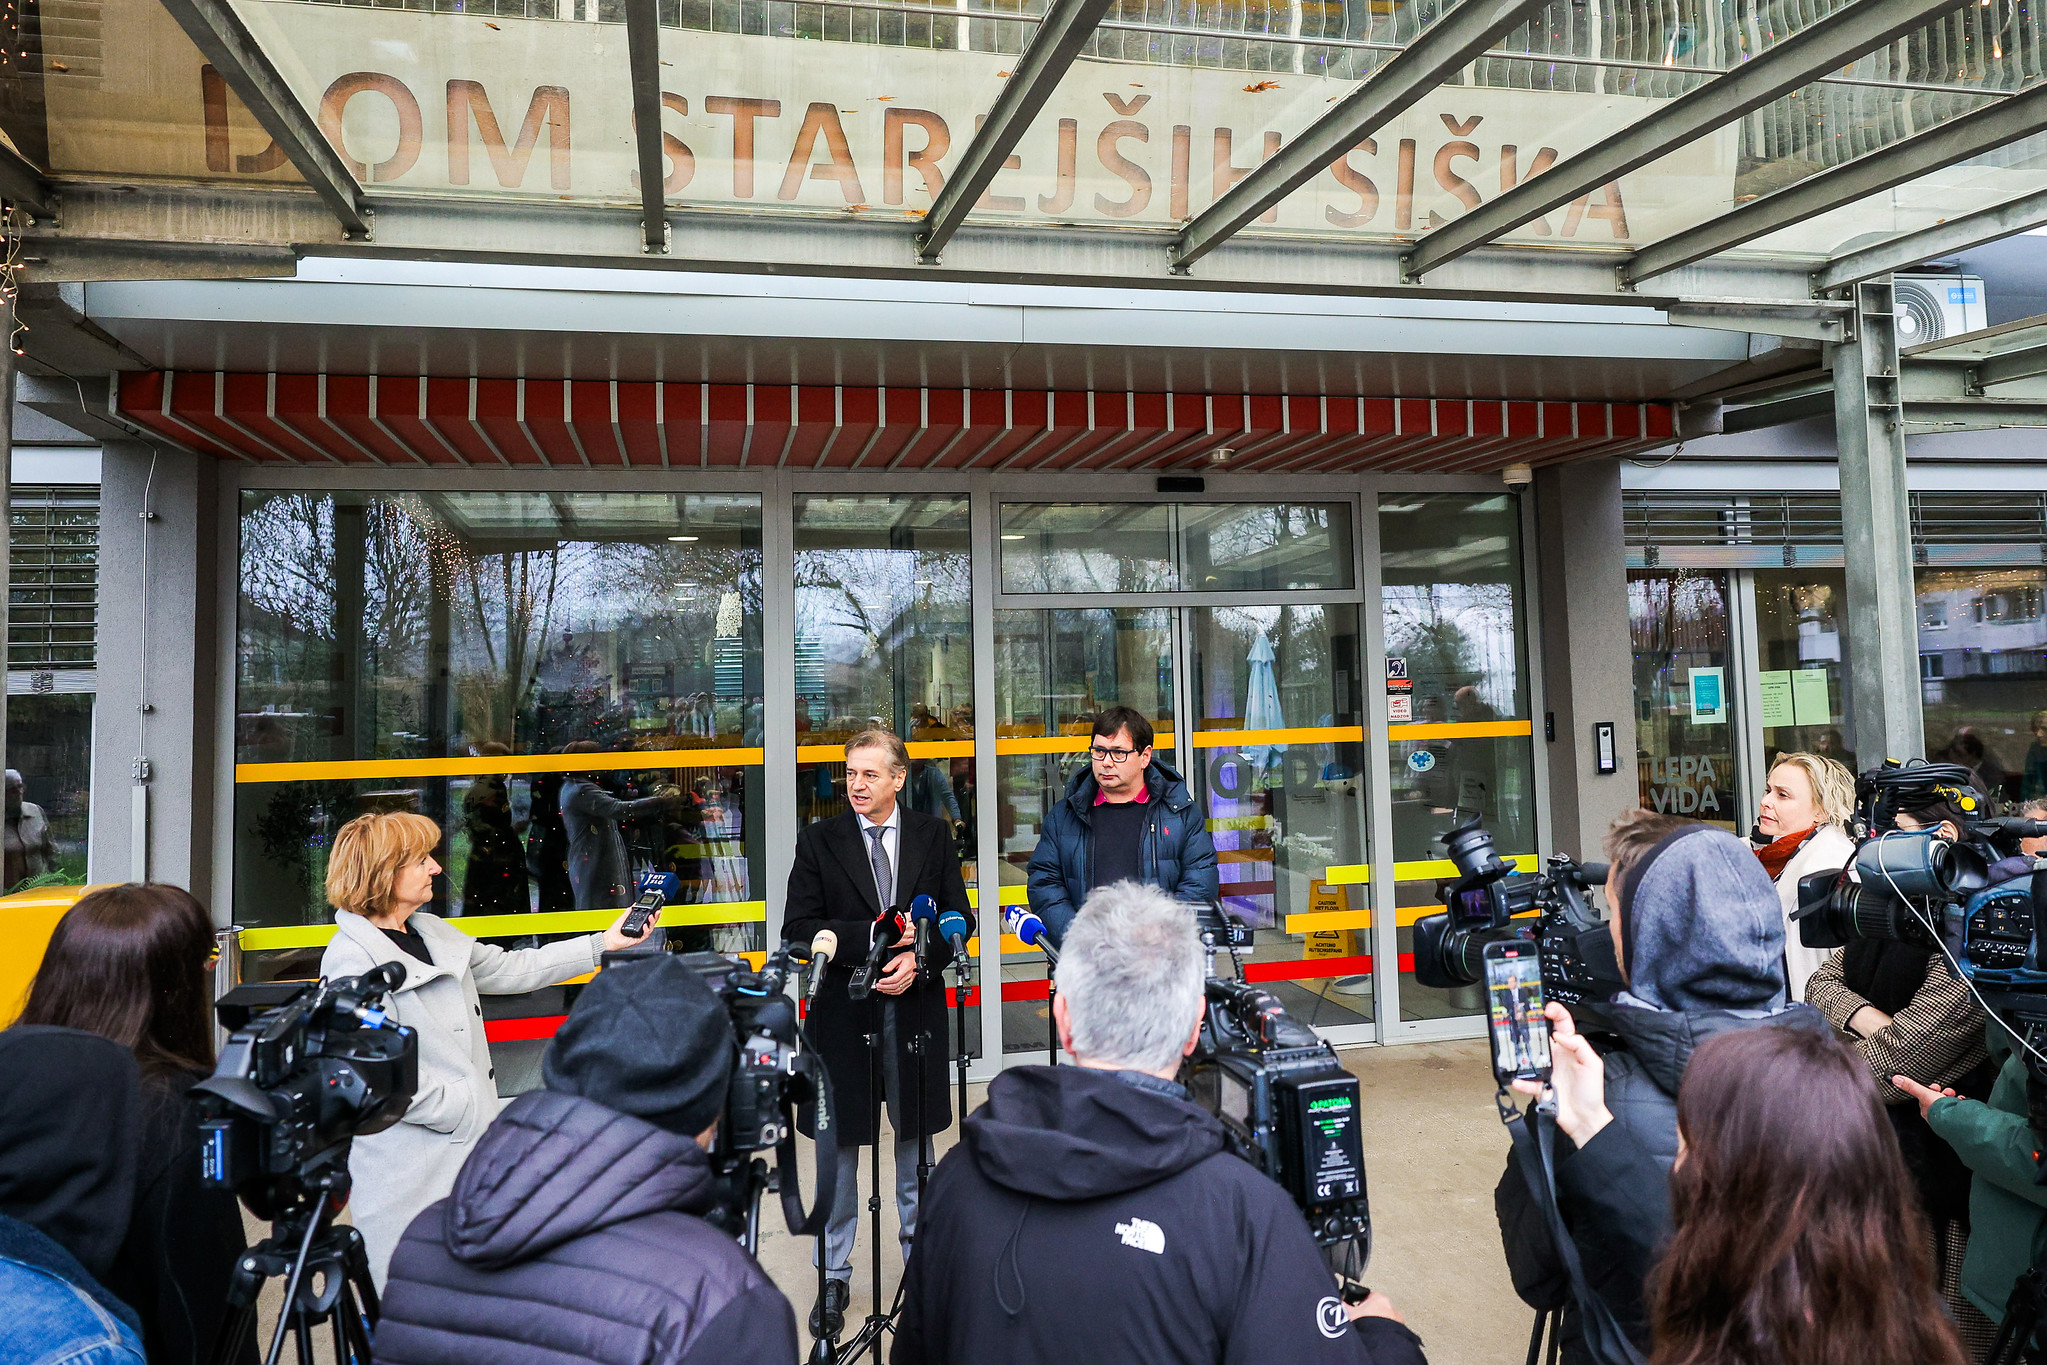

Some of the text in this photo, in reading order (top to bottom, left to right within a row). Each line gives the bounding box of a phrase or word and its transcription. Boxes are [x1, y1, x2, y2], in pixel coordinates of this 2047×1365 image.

[202, 64, 571, 190] DOM
[1651, 755, 1716, 784] LEPA
[1649, 784, 1720, 814] VIDA
[1317, 1097, 1351, 1108] PATONA
